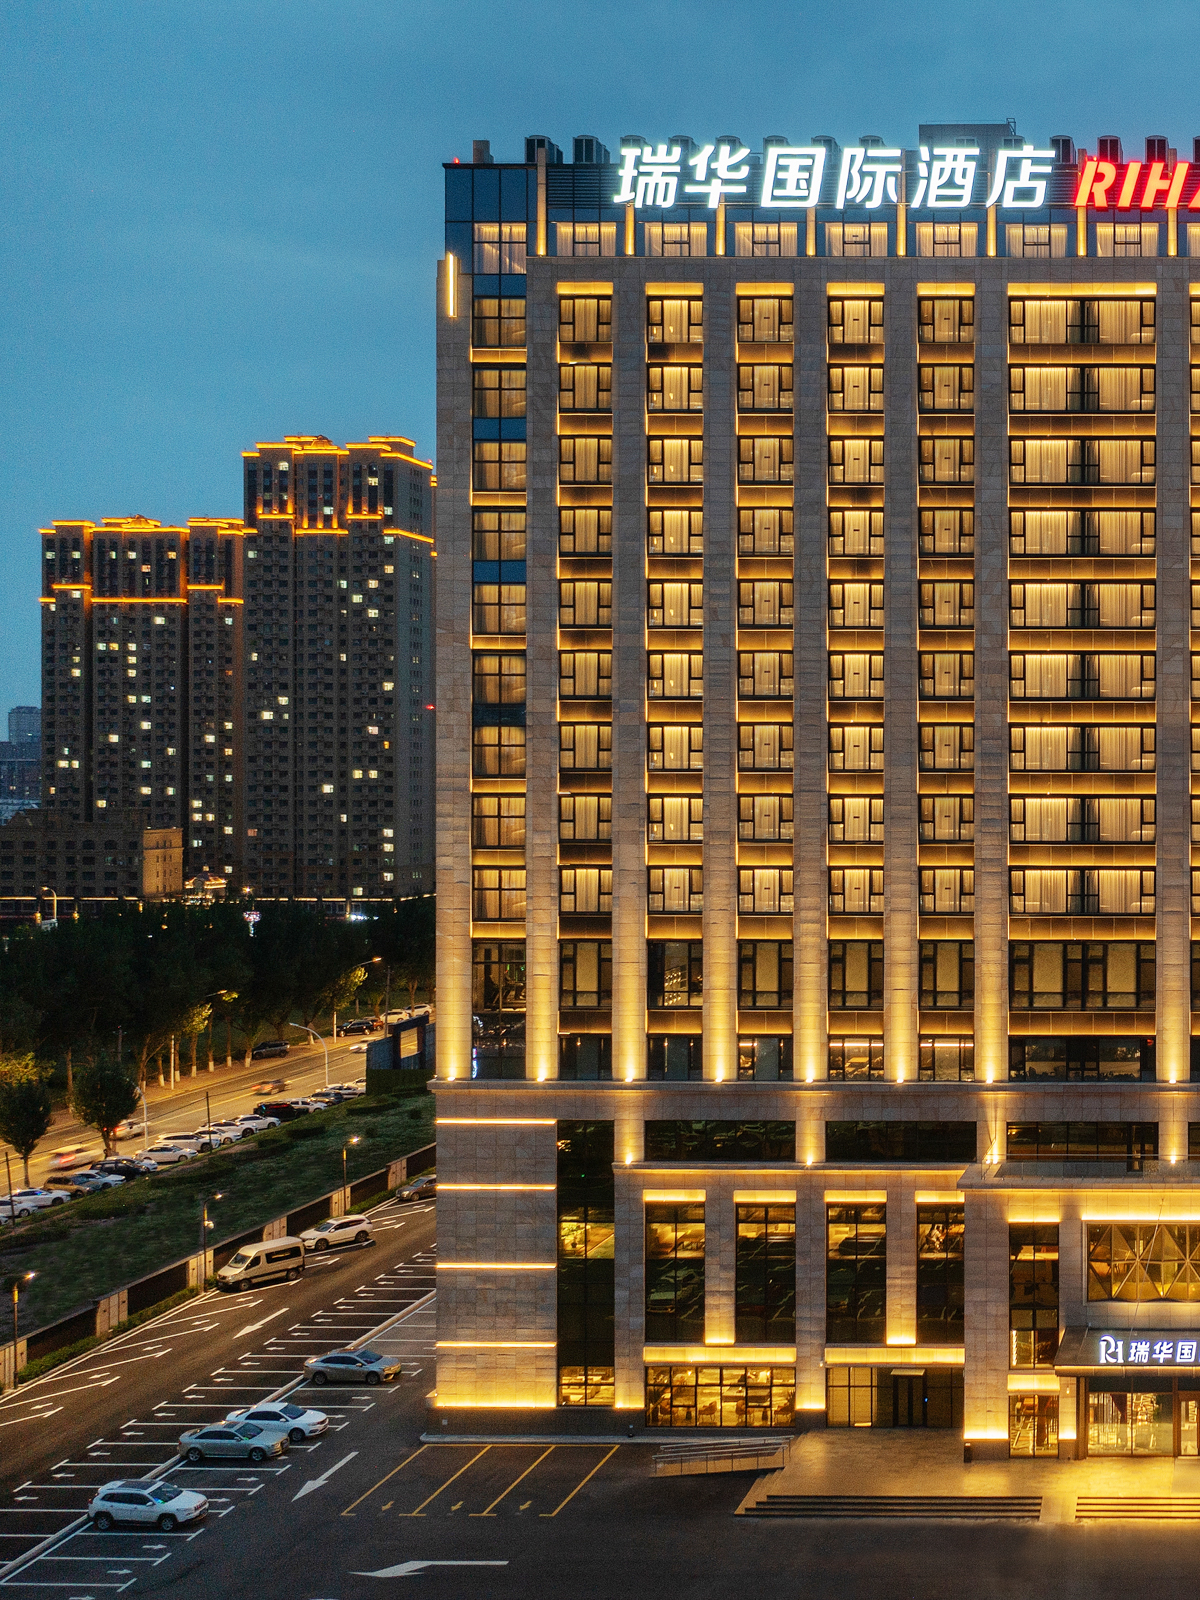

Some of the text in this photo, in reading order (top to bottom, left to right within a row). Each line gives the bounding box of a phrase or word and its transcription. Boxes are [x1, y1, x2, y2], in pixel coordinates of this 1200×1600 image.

[612, 144, 1056, 211] 瑞华国际酒店
